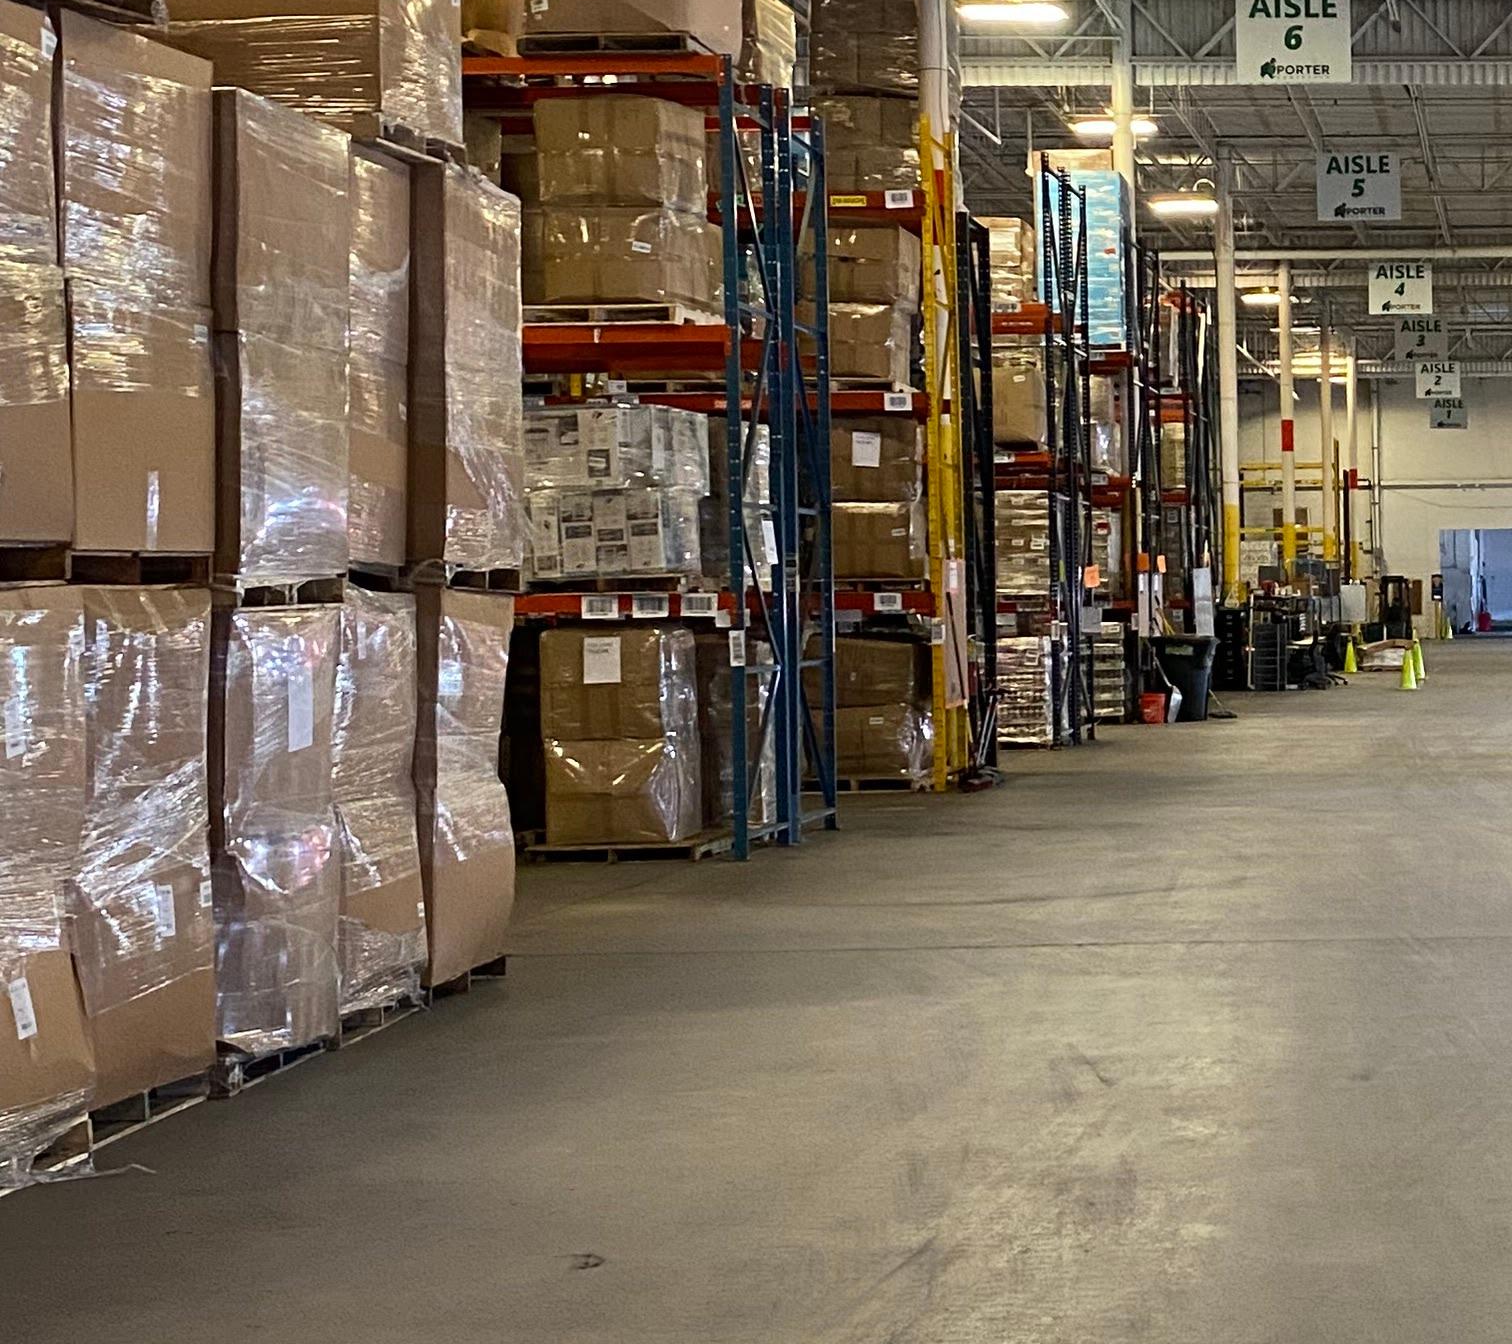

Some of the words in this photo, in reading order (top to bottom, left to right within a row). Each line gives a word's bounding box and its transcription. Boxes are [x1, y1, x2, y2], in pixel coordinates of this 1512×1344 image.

[1284, 25, 1304, 50] 6
[1276, 64, 1330, 75] PORTER
[1326, 155, 1390, 174] AISLE
[1351, 178, 1366, 197] 5
[1346, 207, 1386, 215] PORTER
[1375, 265, 1425, 279] AISLE
[1394, 282, 1406, 296] 4
[1400, 320, 1442, 332] AISLE
[1416, 335, 1426, 347] 3
[1421, 363, 1456, 374] AISLE
[1433, 375, 1442, 385] 2
[1434, 398, 1464, 409] AISLE
[1446, 410, 1452, 419] 1
